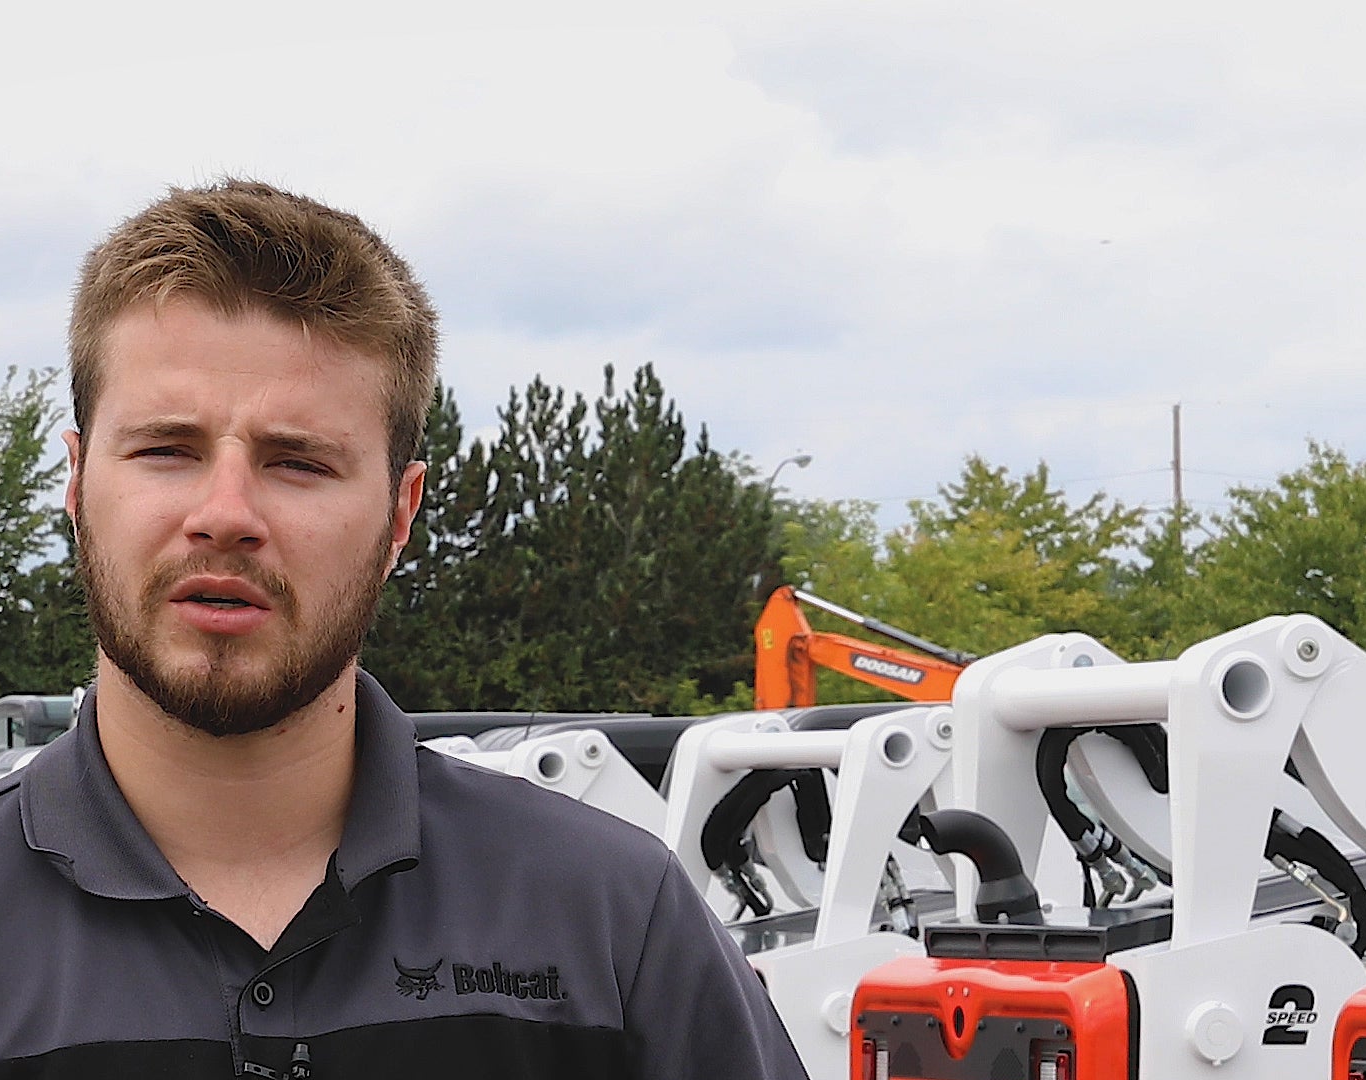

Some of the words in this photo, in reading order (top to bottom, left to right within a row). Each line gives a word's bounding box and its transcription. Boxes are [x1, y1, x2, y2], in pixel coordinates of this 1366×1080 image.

[854, 656, 922, 682] DOOSAN
[1262, 984, 1314, 1045] 2
[1267, 1011, 1317, 1025] SPEED
